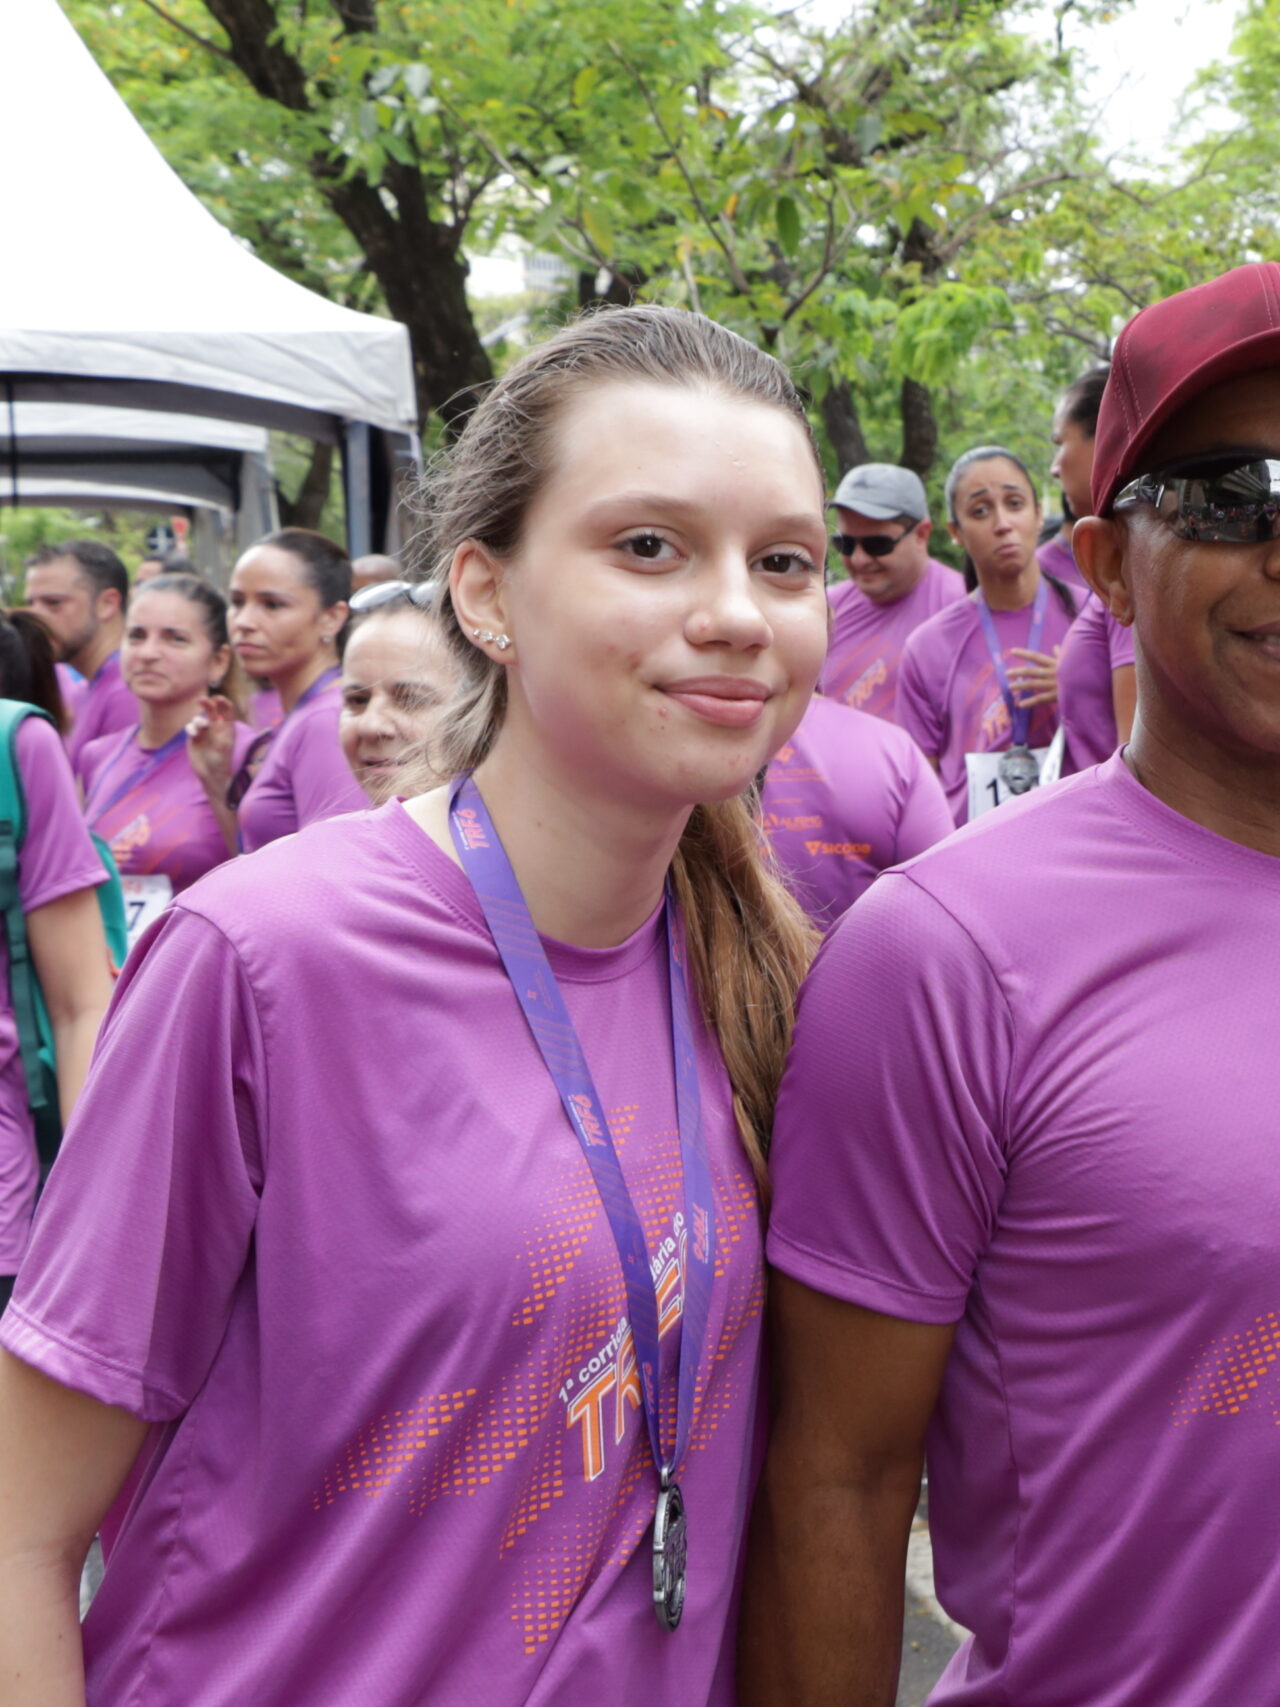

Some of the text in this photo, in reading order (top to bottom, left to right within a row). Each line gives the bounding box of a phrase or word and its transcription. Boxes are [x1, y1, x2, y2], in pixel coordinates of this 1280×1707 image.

[456, 809, 490, 849] TRF6
[572, 1094, 608, 1147] TRF6
[577, 1315, 629, 1385] corrida
